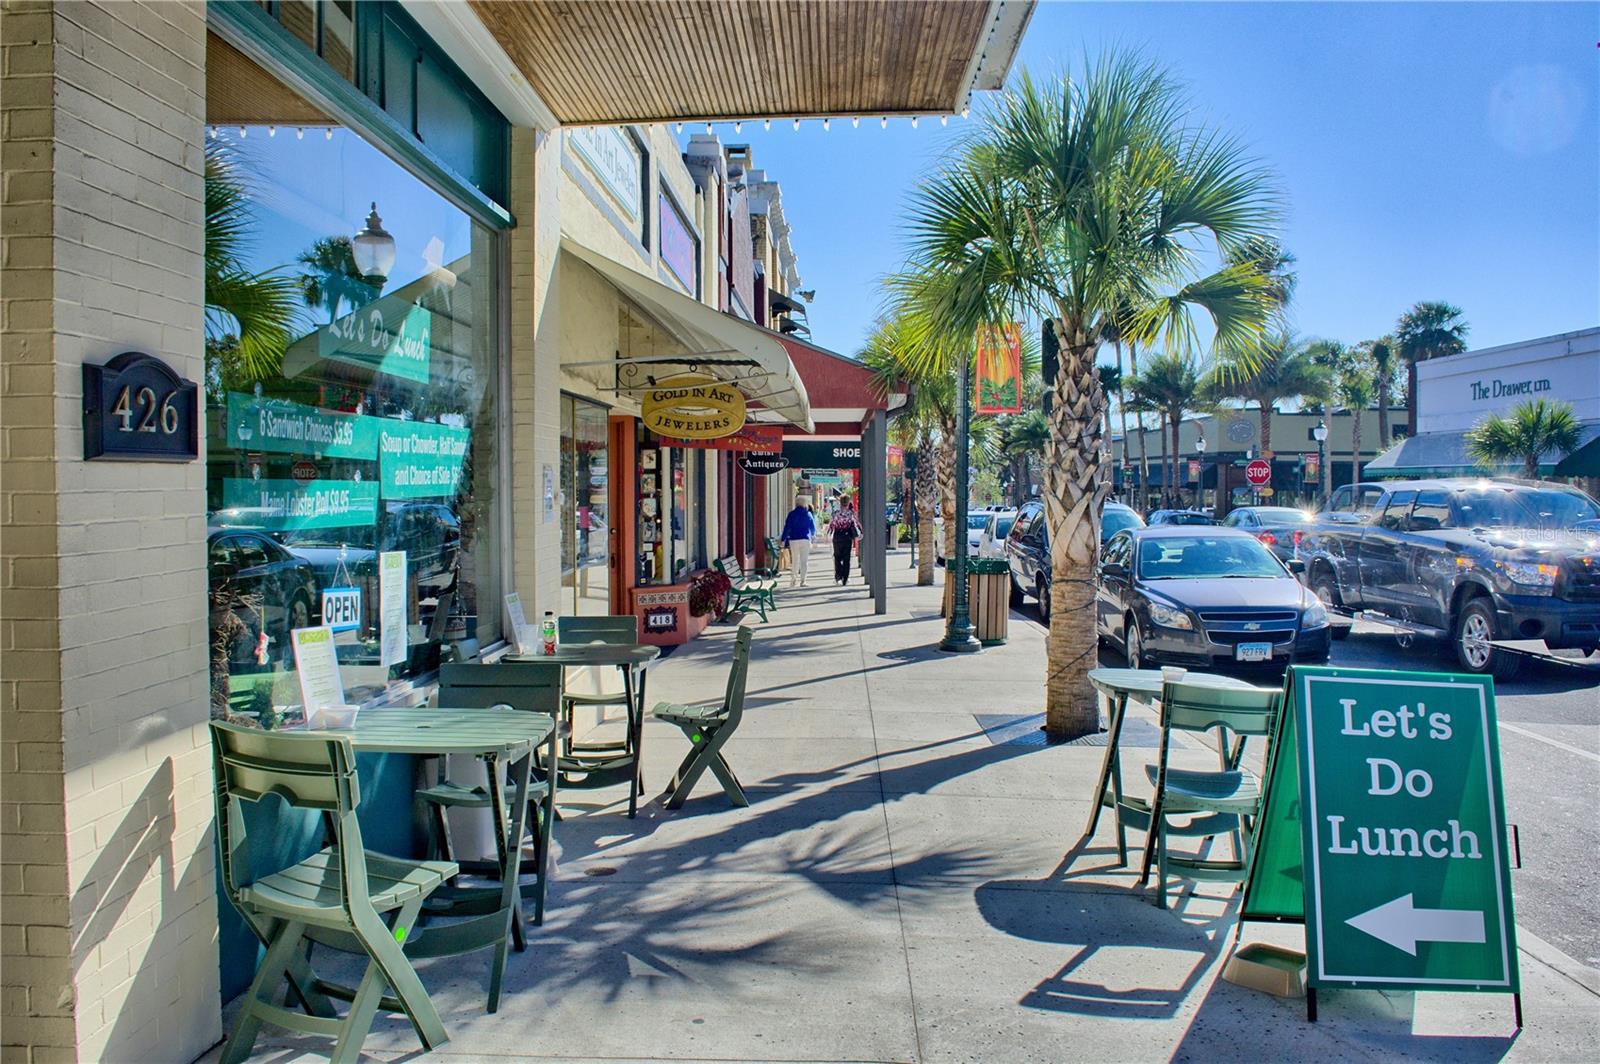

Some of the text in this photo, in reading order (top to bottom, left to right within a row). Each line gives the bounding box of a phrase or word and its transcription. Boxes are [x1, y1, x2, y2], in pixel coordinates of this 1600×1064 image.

[370, 309, 389, 350] Do
[1470, 380, 1490, 401] The
[111, 384, 179, 434] 426
[260, 409, 266, 437] 6
[267, 410, 304, 440] Sandwich
[304, 416, 333, 444] Choices
[655, 416, 730, 431] JEWELERS
[382, 431, 402, 458] Soup
[403, 437, 411, 453] or
[832, 447, 861, 458] SHOE
[395, 466, 409, 486] and
[410, 465, 431, 485] Choice
[432, 466, 440, 484] of
[744, 459, 785, 469] Antiques
[1247, 468, 1269, 478] STOP
[286, 492, 315, 517] Lobster
[325, 595, 359, 624] OPEN
[652, 615, 671, 625] 418
[1339, 698, 1452, 740] Let's
[1366, 757, 1433, 797] Do
[1327, 815, 1482, 859] Lunch
